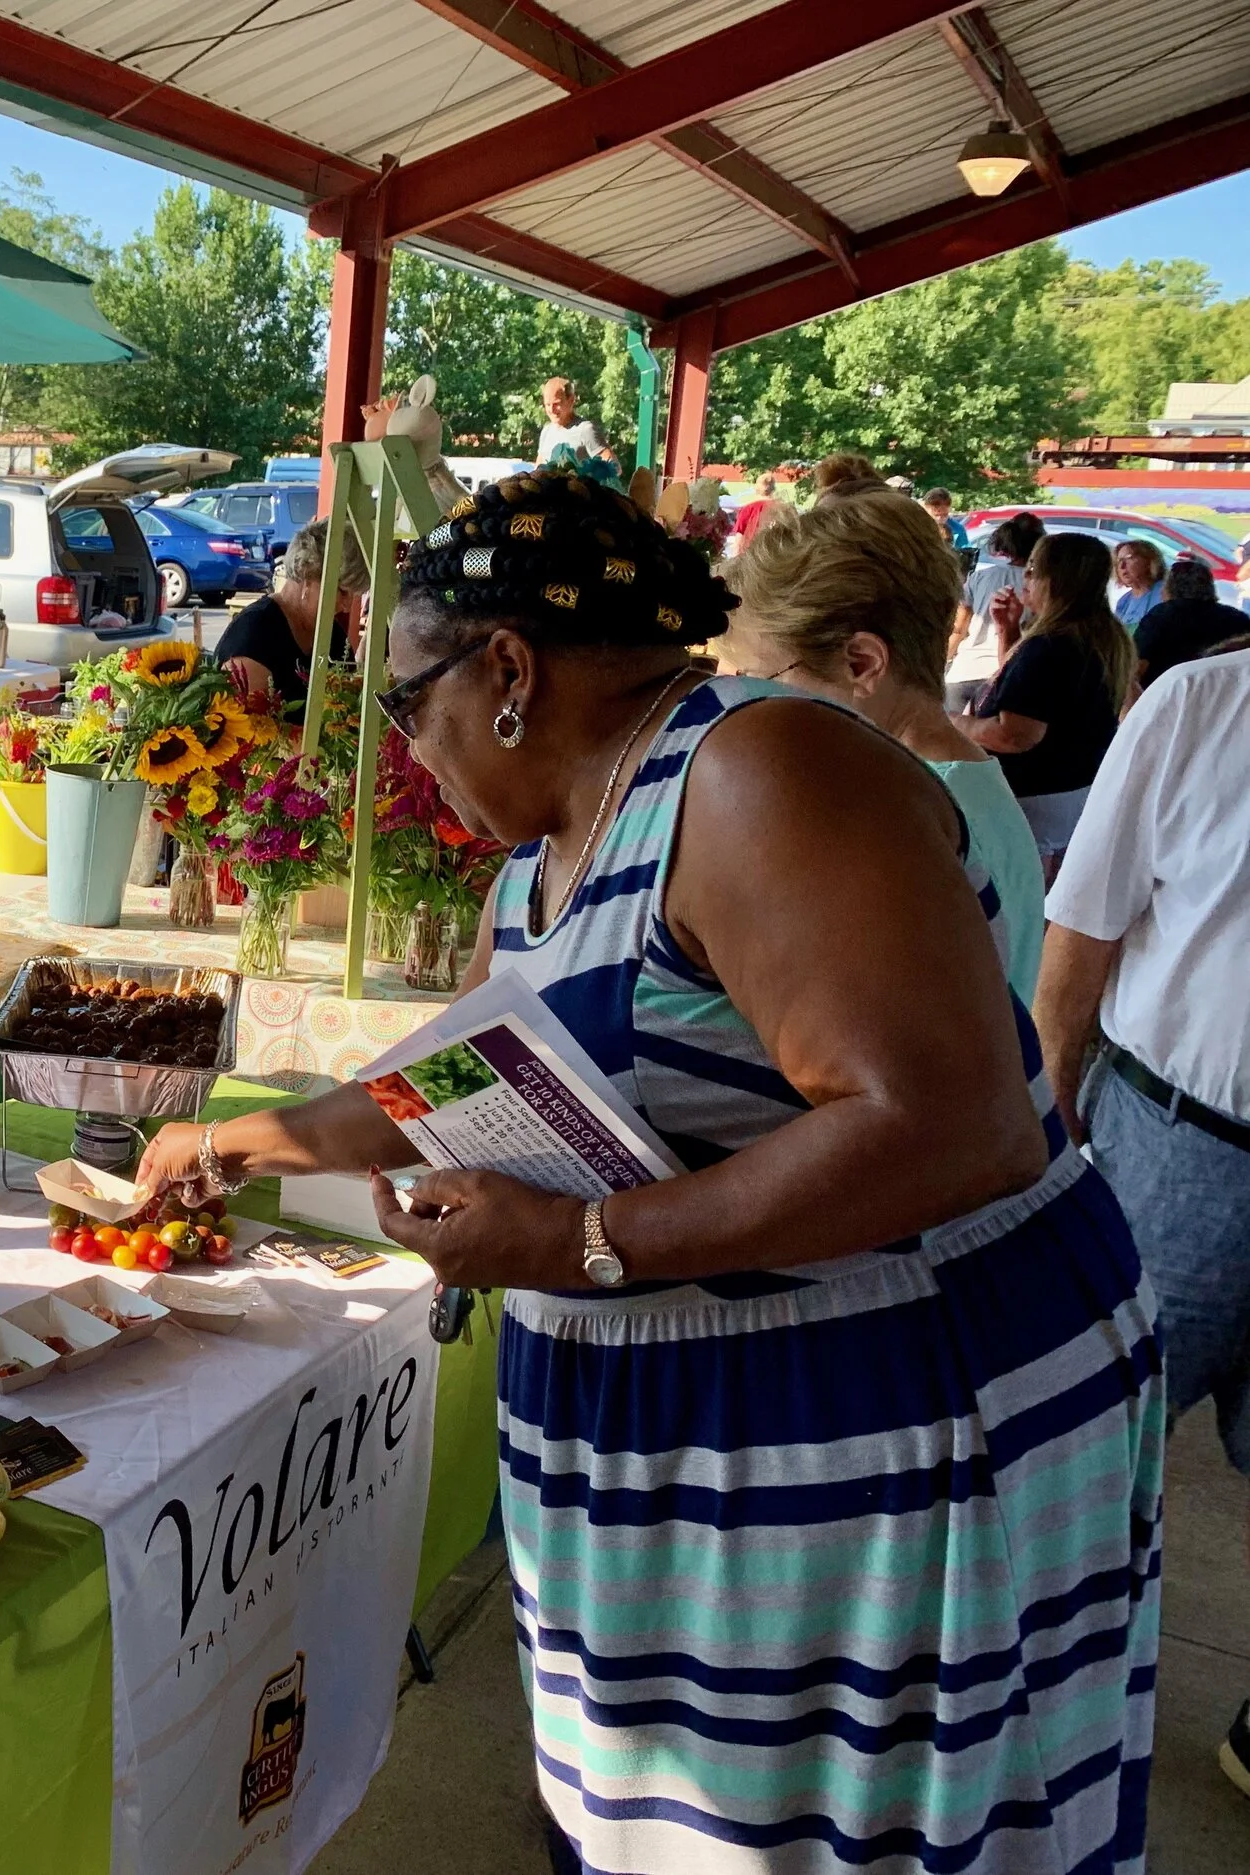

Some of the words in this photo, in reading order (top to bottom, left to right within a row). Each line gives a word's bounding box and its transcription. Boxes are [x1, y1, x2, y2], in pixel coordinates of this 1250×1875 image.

[469, 1116, 488, 1137] Sept.
[488, 1135, 500, 1145] 17
[479, 1113, 496, 1131] Aug.
[495, 1129, 508, 1140] 20
[486, 1108, 505, 1124] July
[504, 1123, 516, 1133] 16
[497, 1103, 518, 1121] June
[517, 1120, 529, 1131] 18
[501, 1088, 520, 1108] Four
[517, 1107, 541, 1130] South
[539, 1129, 574, 1162] Frankfort
[571, 1160, 591, 1180] Food
[589, 1179, 607, 1198] Shar
[516, 1064, 543, 1086] GET
[537, 1085, 553, 1099] 10
[549, 1098, 584, 1131] KINDS
[581, 1130, 601, 1146] OF
[596, 1144, 637, 1188] VEGGIES
[518, 1083, 543, 1107] FOR
[539, 1106, 557, 1121] AS
[553, 1119, 593, 1156] LITTLE
[587, 1156, 605, 1170] AS
[601, 1168, 618, 1183] $6
[528, 1059, 547, 1076] JOIN
[546, 1073, 560, 1089] THE
[556, 1086, 579, 1112] SOUTH
[577, 1107, 614, 1144] FRANKFORT
[611, 1139, 631, 1161] FOOD
[8, 1466, 33, 1481] olare
[145, 1357, 417, 1639] Volare
[176, 1577, 274, 1678] ITALIAN
